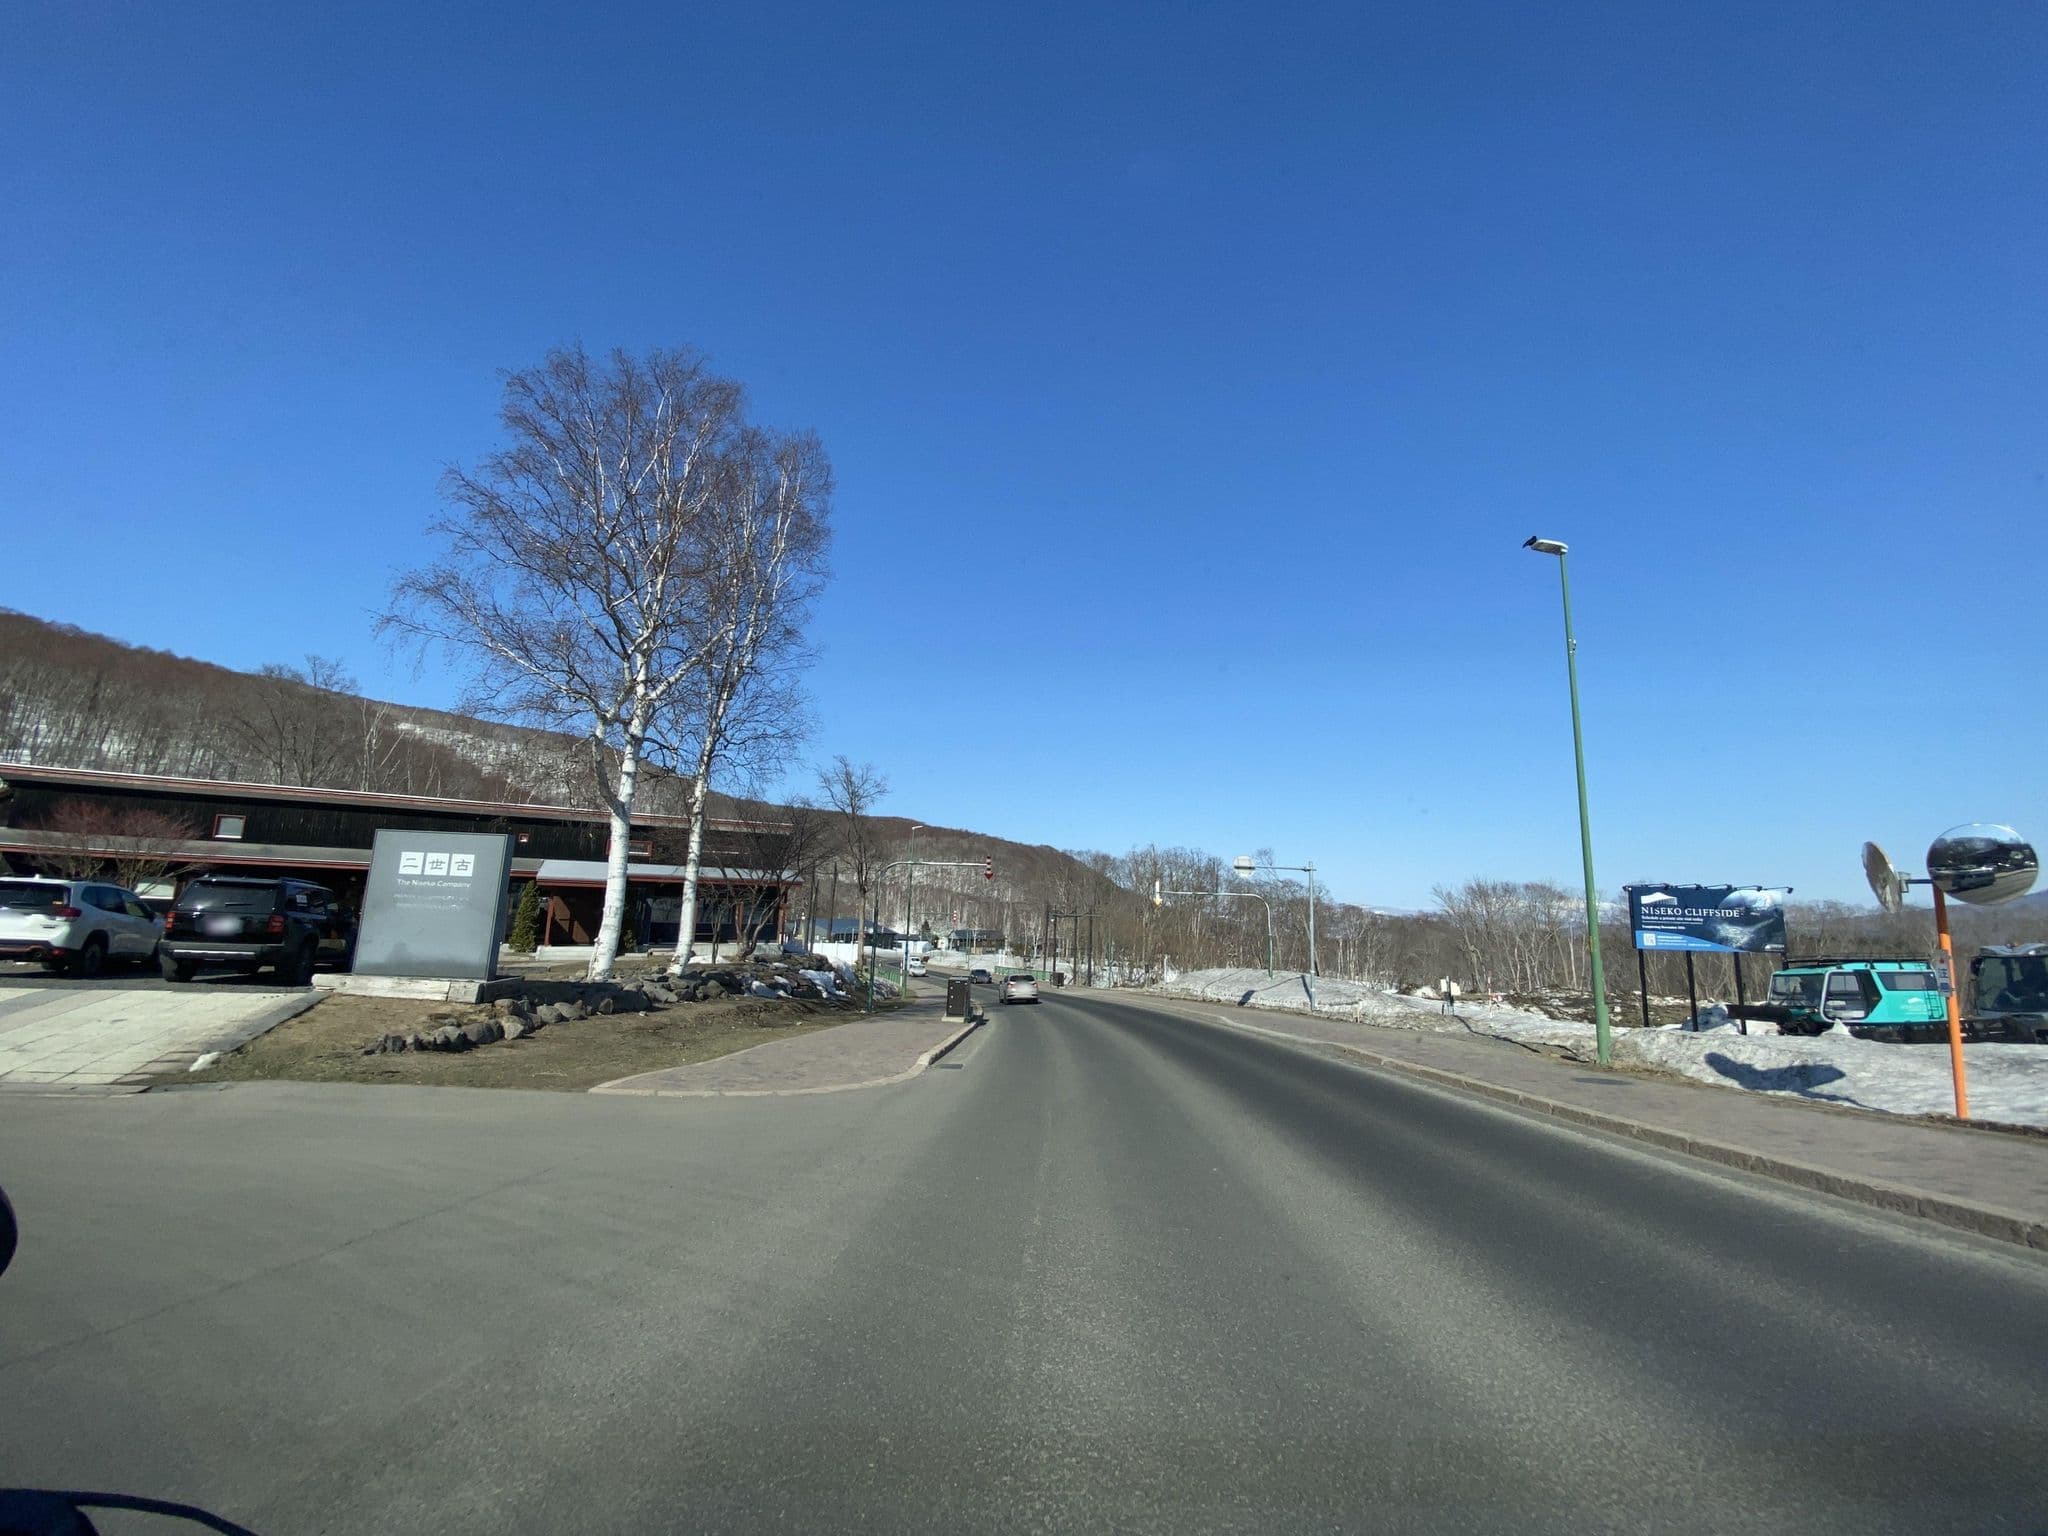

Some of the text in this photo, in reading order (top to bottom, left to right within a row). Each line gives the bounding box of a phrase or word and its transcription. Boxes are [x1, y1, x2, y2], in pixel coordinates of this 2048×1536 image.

[401, 856, 473, 873] 二世古
[397, 878, 411, 886] The
[1641, 906, 1682, 915] NISEKO
[1685, 908, 1740, 918] CLIFFSIDE
